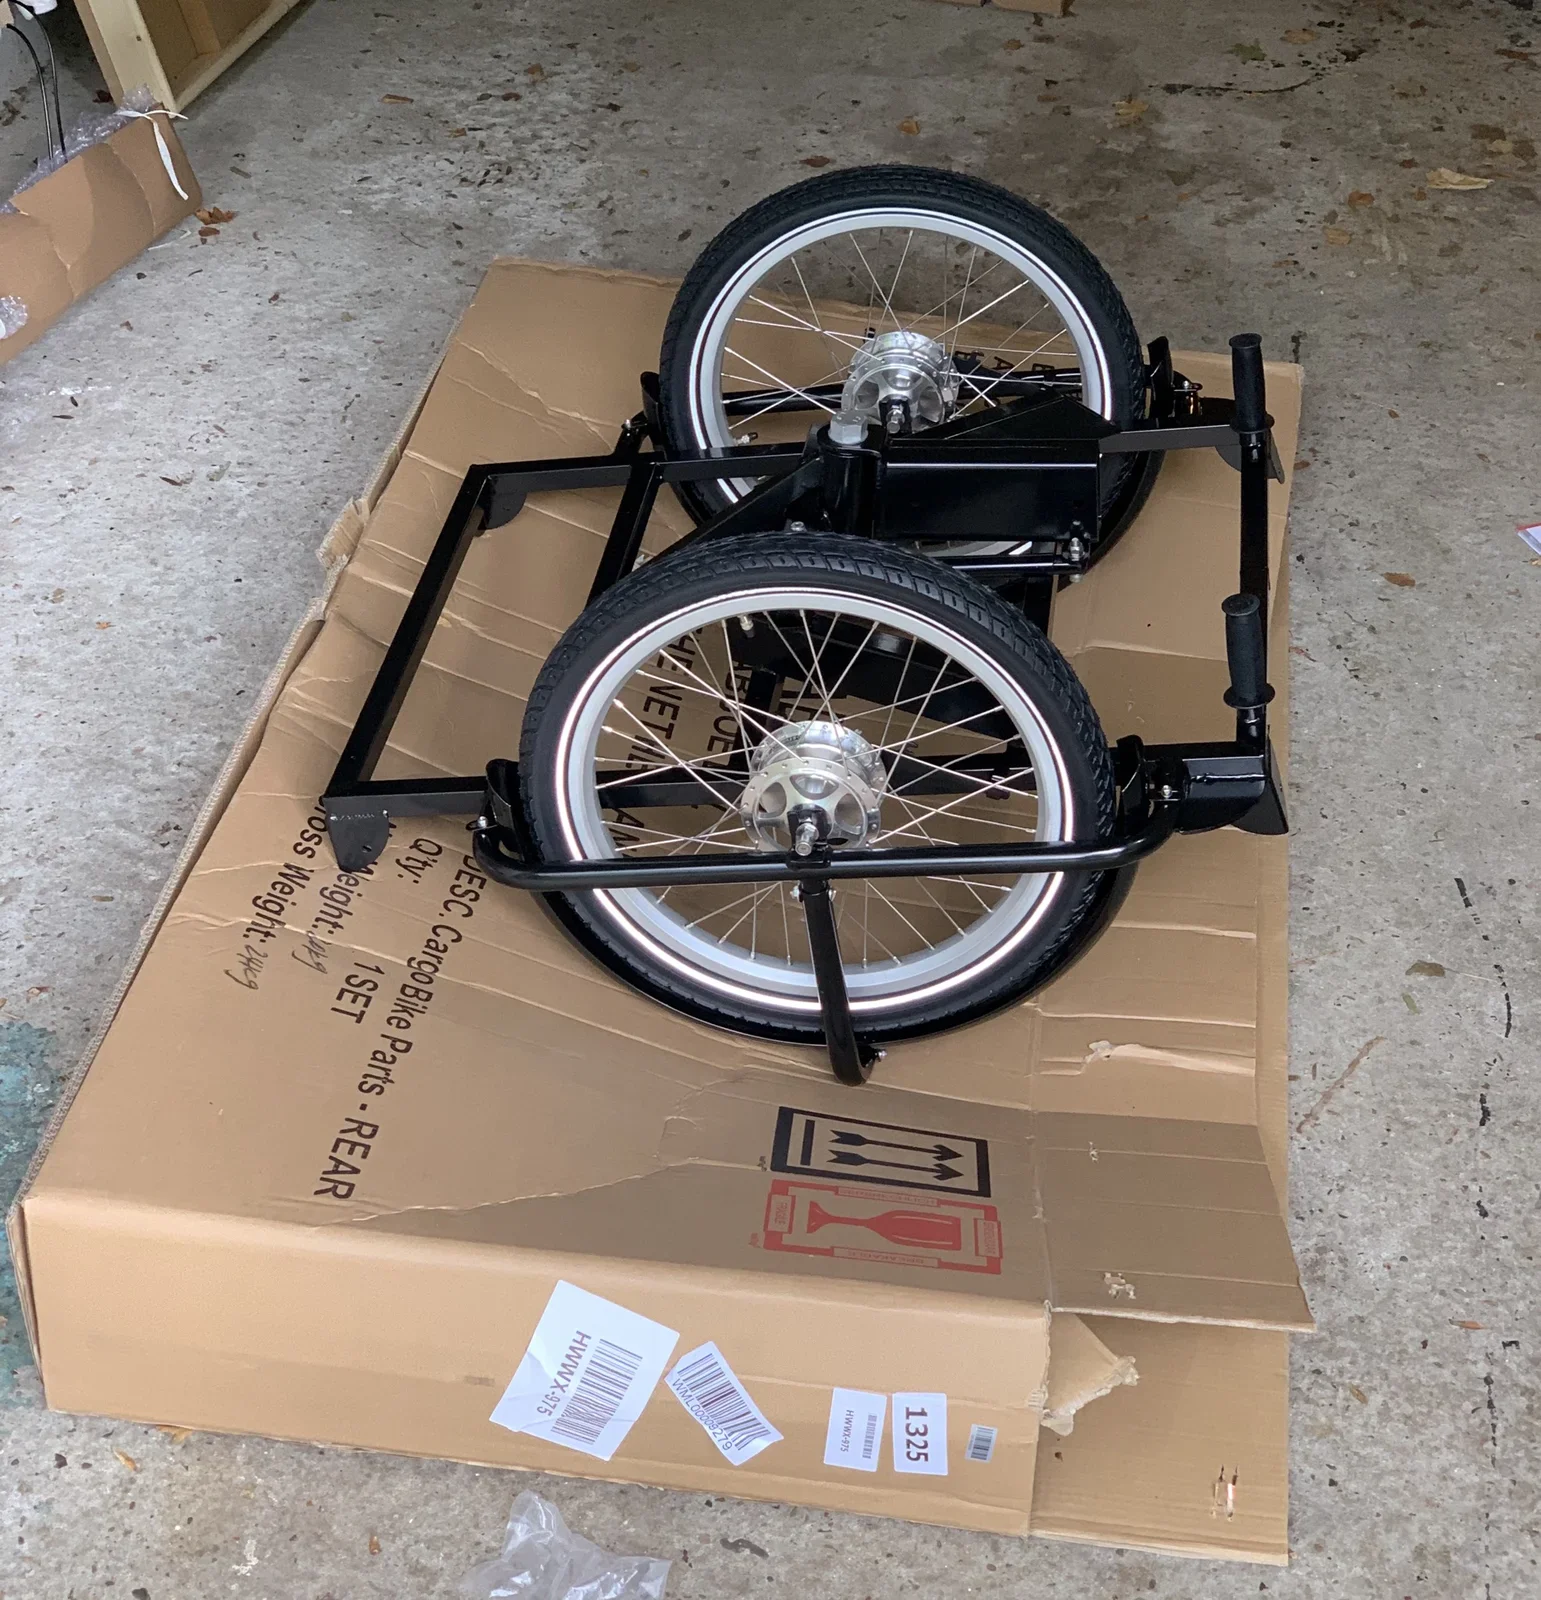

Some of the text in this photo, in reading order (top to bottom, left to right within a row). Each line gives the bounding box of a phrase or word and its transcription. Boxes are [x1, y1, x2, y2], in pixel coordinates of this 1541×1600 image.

[242, 862, 310, 948] Weight:
[331, 971, 379, 1024] SET
[385, 923, 463, 1031] CargoBike
[358, 1033, 413, 1096] Parts
[314, 1116, 379, 1199] REAR
[535, 1330, 592, 1417] HWWX-975
[904, 1406, 929, 1463] 1325
